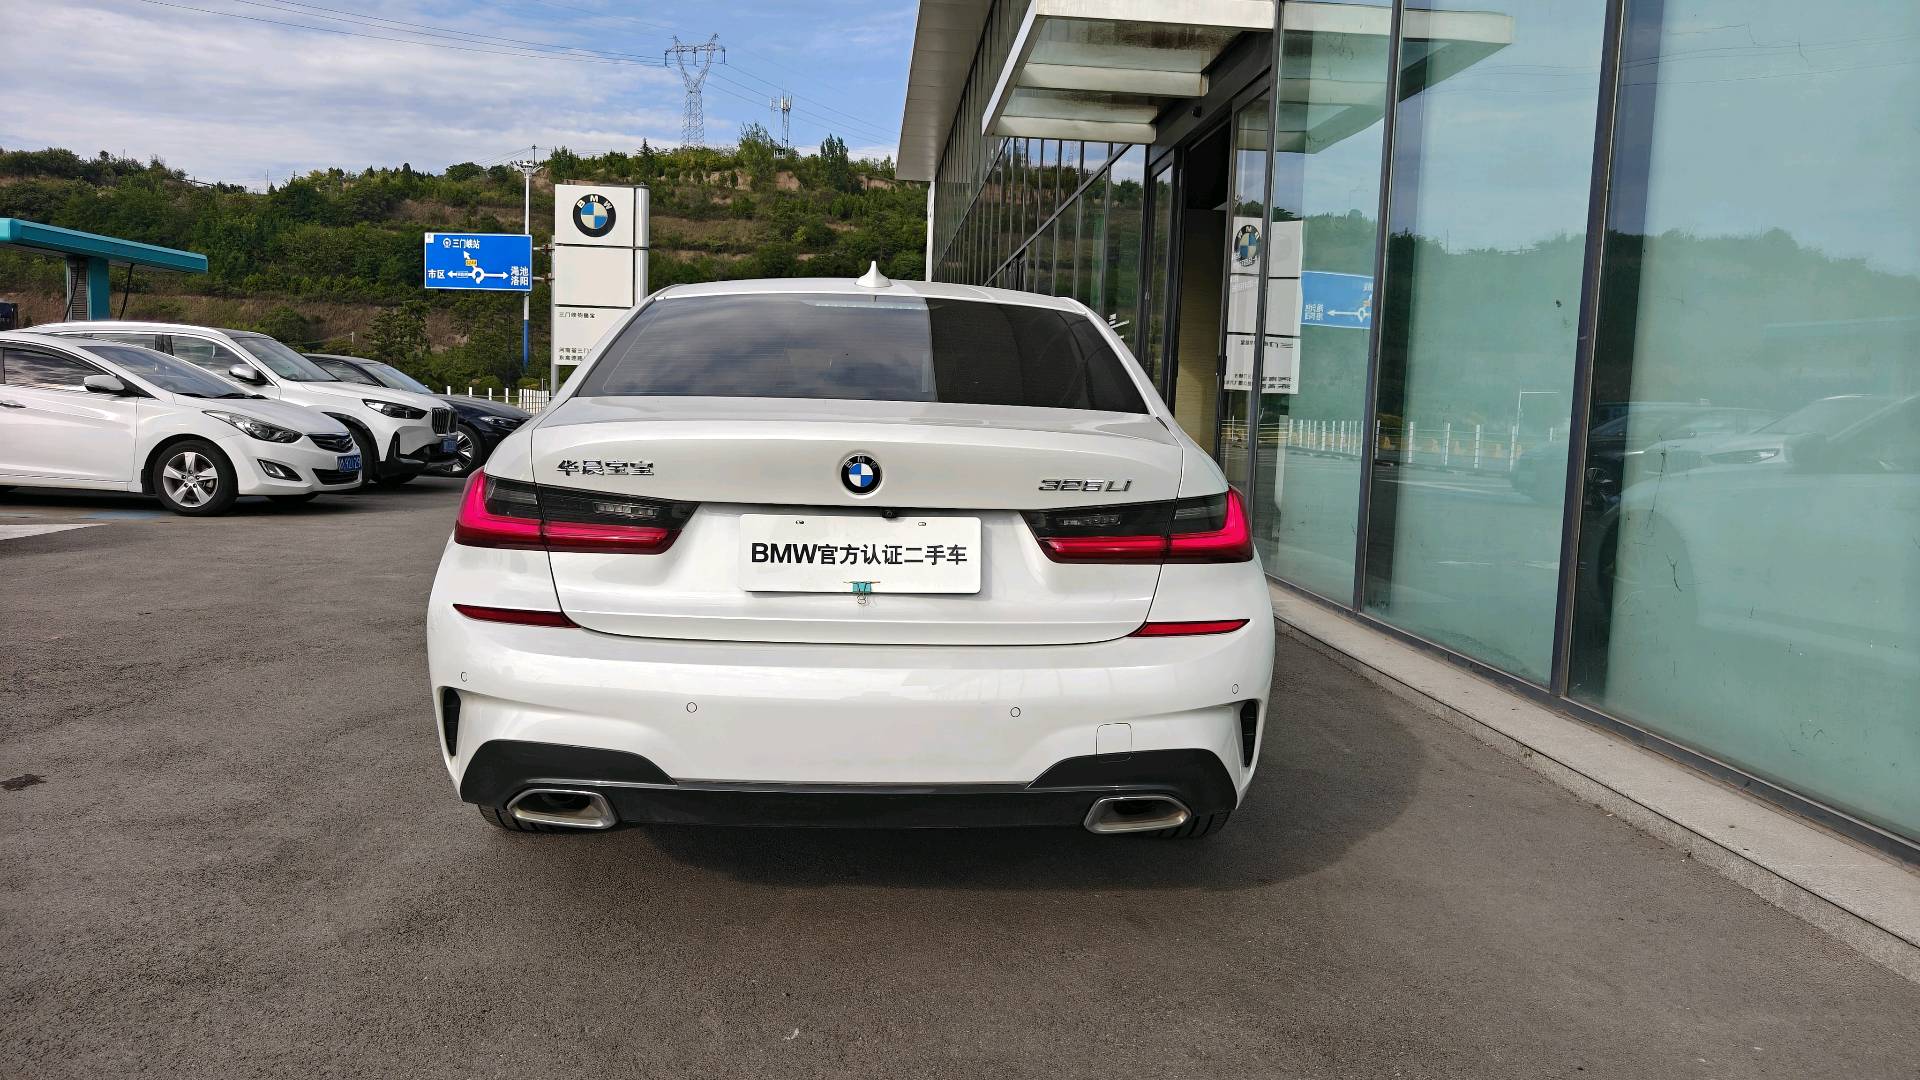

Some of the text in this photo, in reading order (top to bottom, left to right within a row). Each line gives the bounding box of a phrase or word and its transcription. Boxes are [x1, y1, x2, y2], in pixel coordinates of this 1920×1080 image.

[577, 194, 613, 210] BMW
[428, 269, 445, 279] 市区
[510, 276, 529, 287] 洛阳
[750, 542, 968, 566] BMW官方认证二手车
